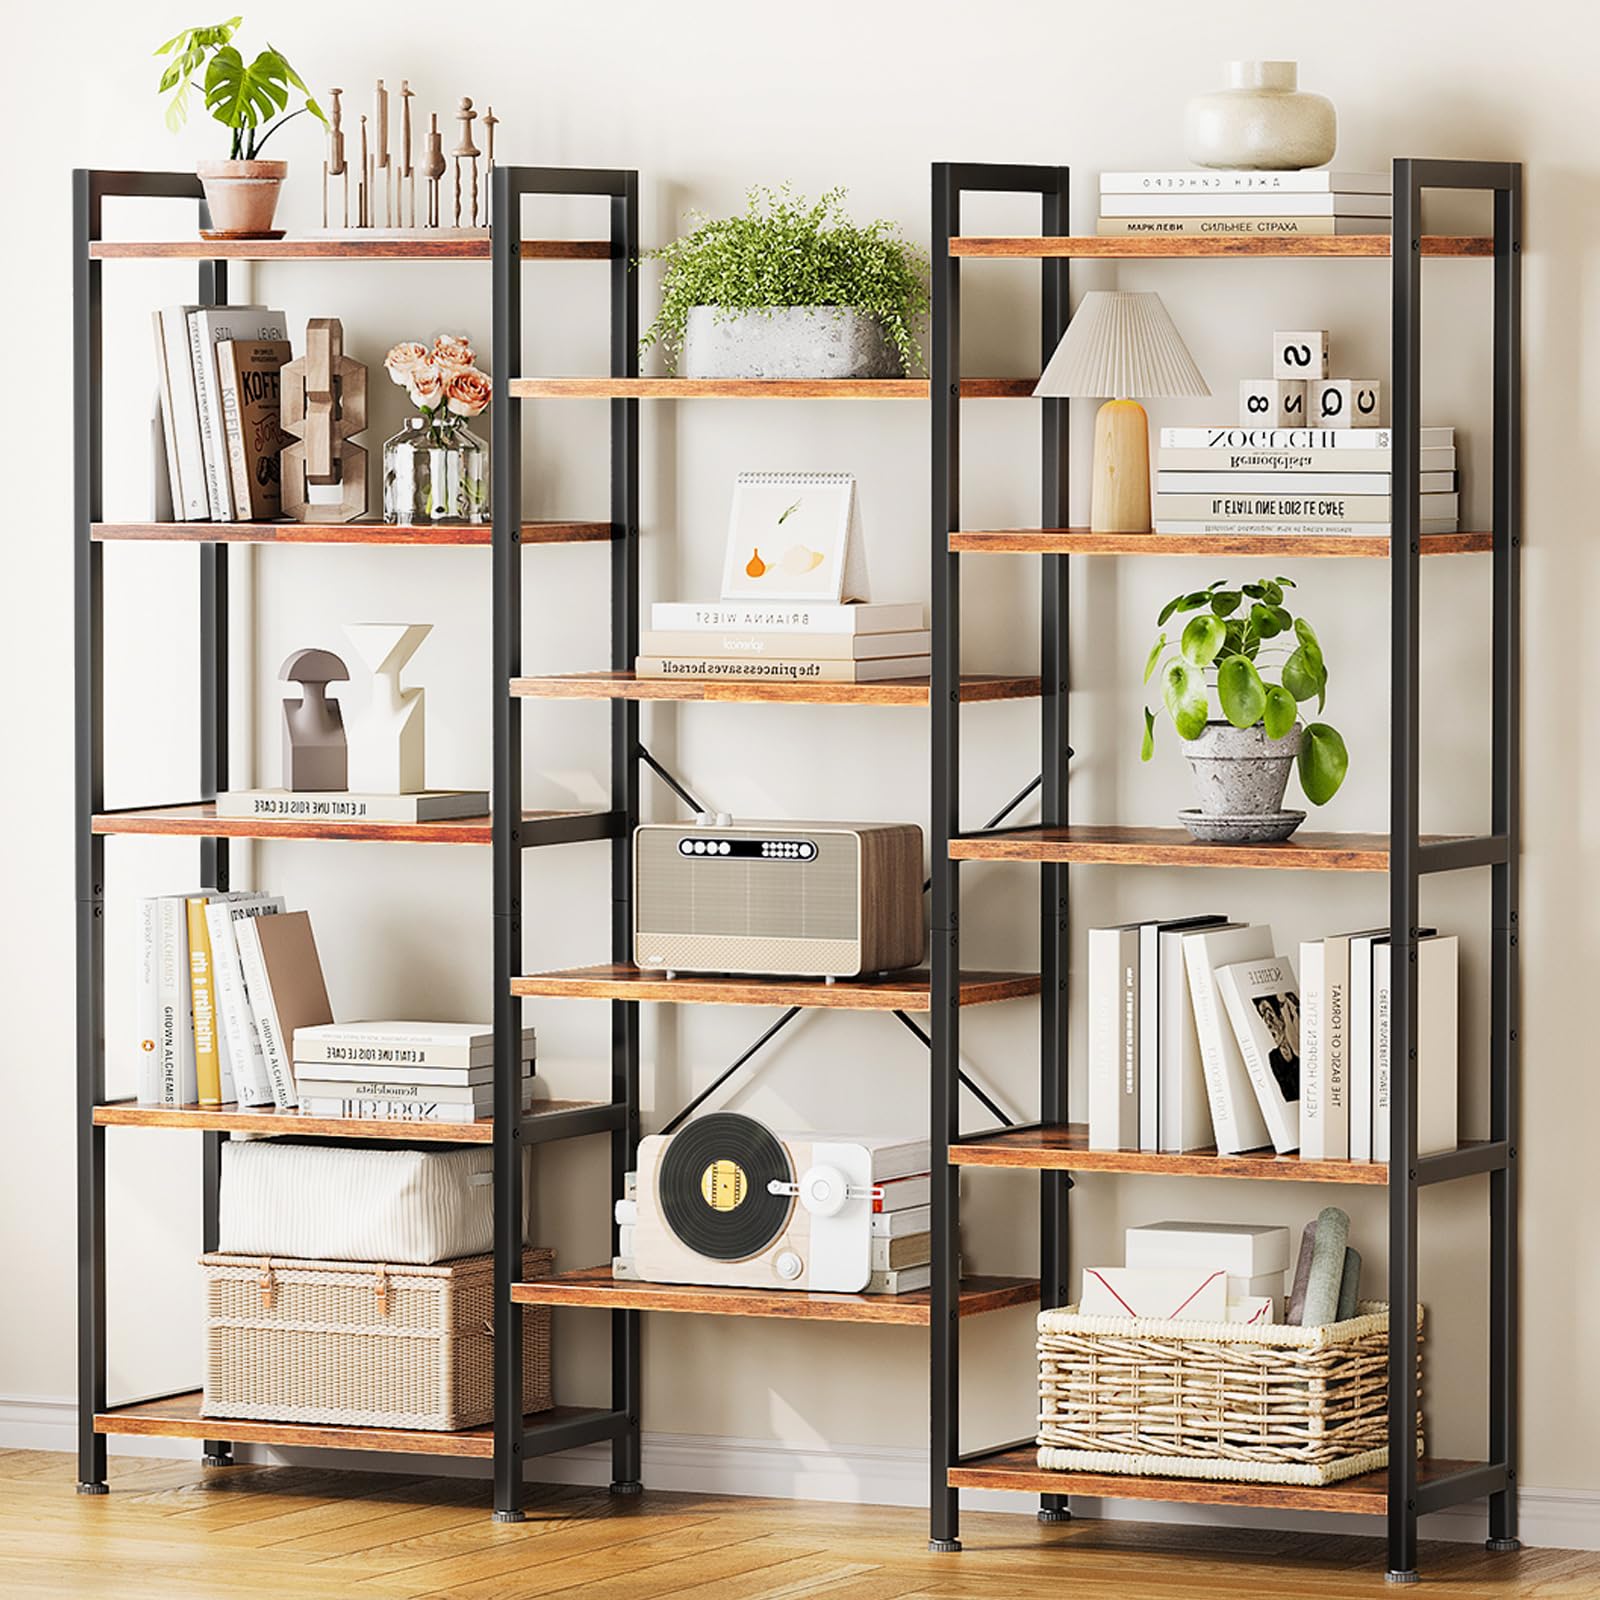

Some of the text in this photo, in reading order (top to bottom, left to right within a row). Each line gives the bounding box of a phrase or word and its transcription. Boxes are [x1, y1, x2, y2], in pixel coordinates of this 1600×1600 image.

[1201, 222, 1253, 232] СИЛЬНЕЕ
[1257, 222, 1298, 232] СТРАХА
[164, 1006, 174, 1105] GROWN ALCHEMIS
